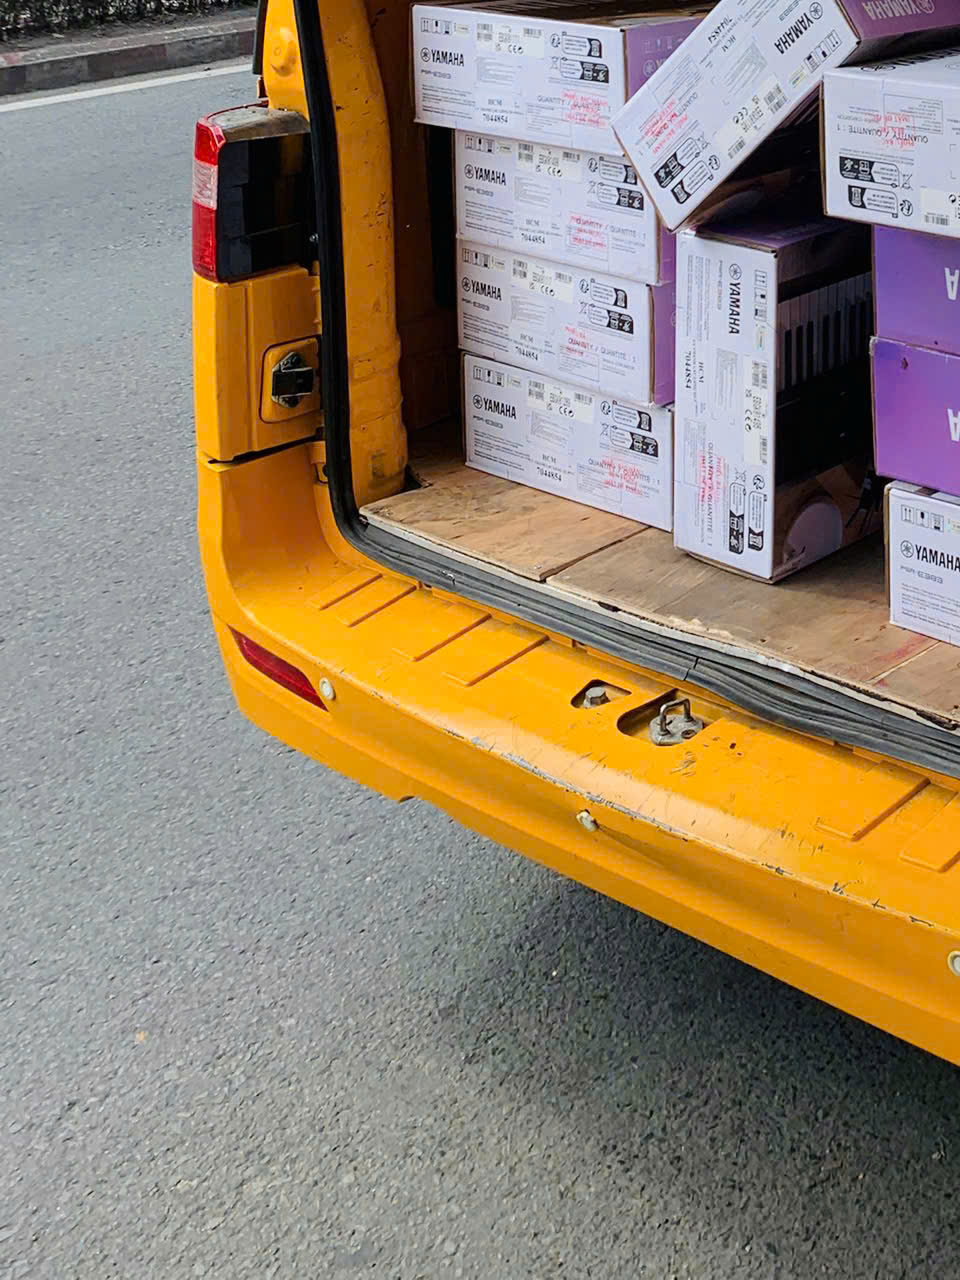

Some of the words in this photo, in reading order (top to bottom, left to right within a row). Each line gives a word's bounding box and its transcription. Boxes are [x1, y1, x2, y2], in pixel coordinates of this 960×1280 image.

[774, 12, 815, 55] YAMAHA
[431, 49, 465, 67] YAMAHA
[474, 166, 507, 186] YAMAHA
[471, 280, 502, 301] YAMAHA
[728, 282, 741, 334] YAMAHA
[484, 397, 517, 420] YAMAHA
